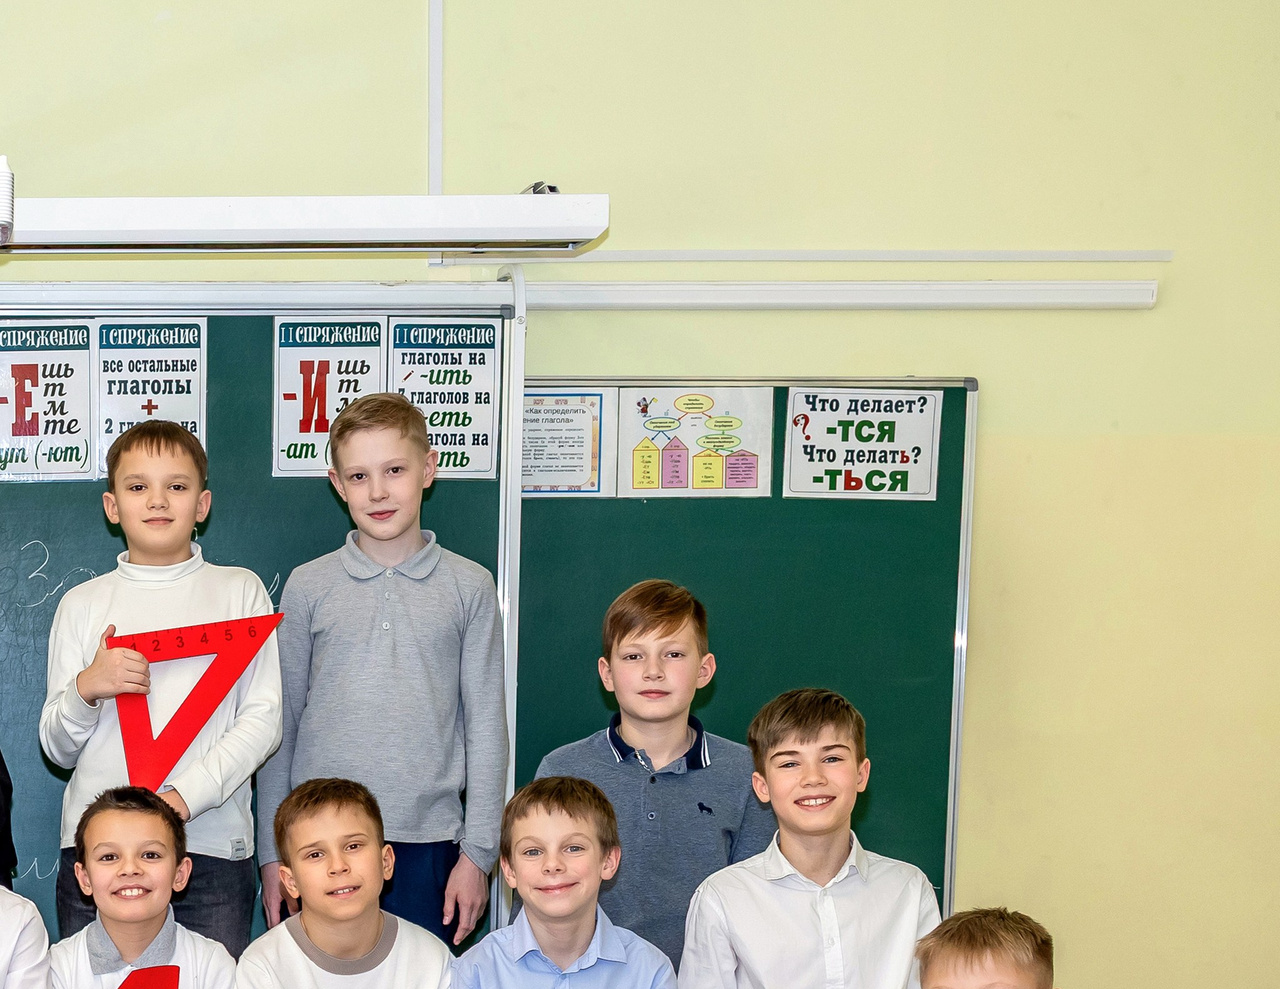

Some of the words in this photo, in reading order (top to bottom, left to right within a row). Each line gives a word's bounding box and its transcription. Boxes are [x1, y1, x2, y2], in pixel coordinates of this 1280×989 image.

[102, 359, 123, 373] все
[128, 359, 197, 373] остальные
[401, 352, 462, 366] глаголы
[469, 353, 486, 365] на
[107, 379, 192, 395] глаголы
[411, 391, 469, 404] глаголов
[475, 391, 490, 404] на
[804, 394, 840, 412] Что
[846, 396, 927, 415] делает?
[43, 419, 81, 435] те
[105, 418, 113, 434] 2
[472, 433, 488, 446] на
[34, 439, 89, 470] (-ют)
[280, 442, 318, 459] -ат
[802, 445, 836, 462] Что
[843, 446, 922, 466] делать?
[152, 639, 161, 652] 2
[176, 636, 185, 648] 3
[200, 632, 209, 645] 4
[224, 628, 233, 641] 5
[248, 626, 257, 638] 6
